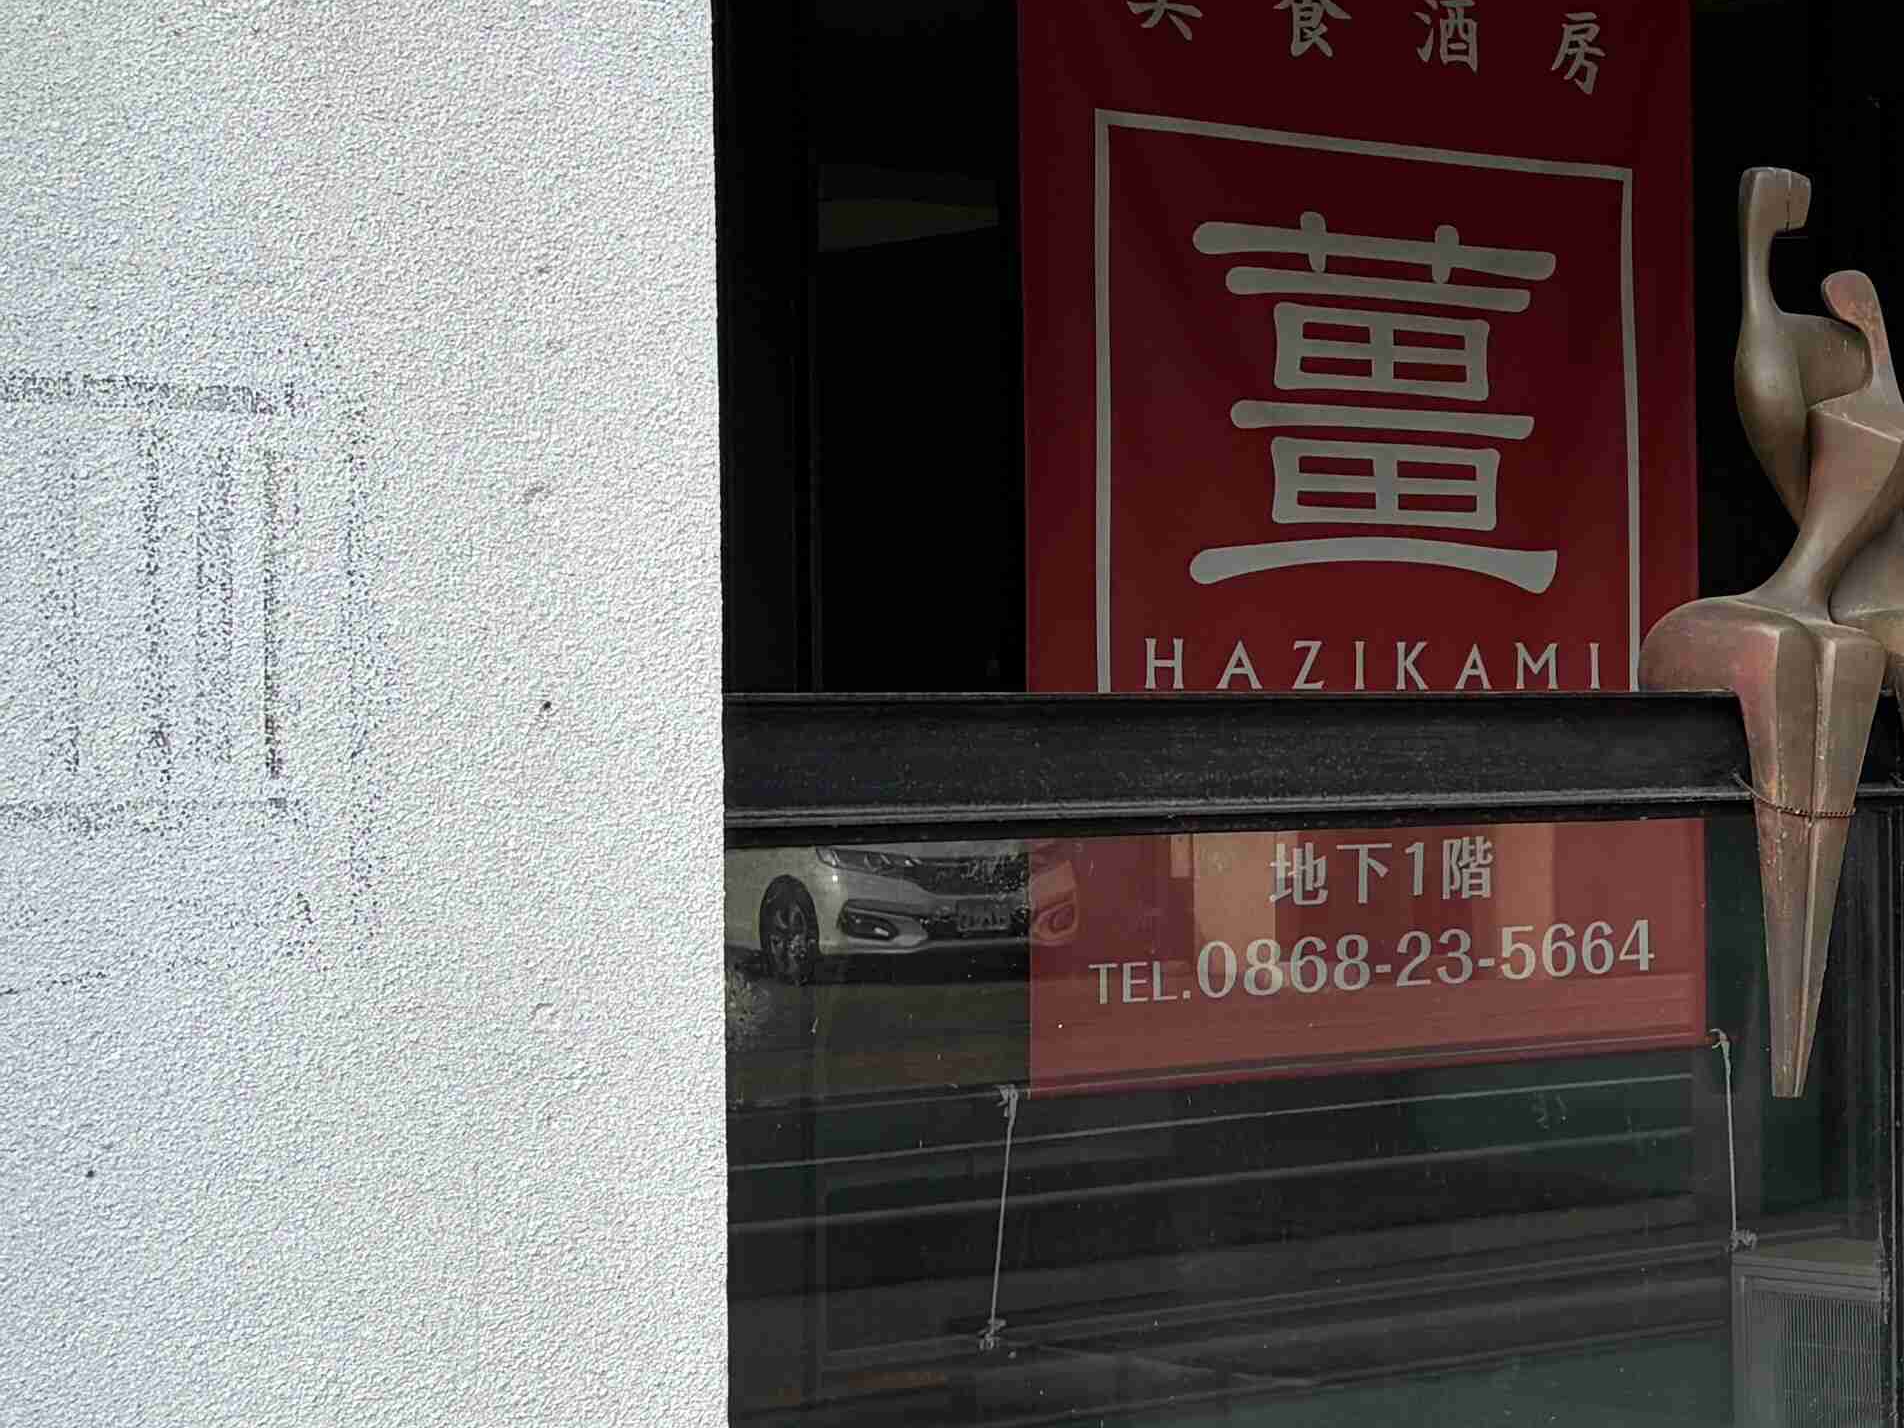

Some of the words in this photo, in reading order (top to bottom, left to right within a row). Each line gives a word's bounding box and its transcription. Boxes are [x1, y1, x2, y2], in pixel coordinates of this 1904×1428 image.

[1189, 210, 1559, 595] 薑
[1144, 637, 1602, 691] HAZIKAMI
[1268, 836, 1494, 906] 地下1階
[1088, 919, 1656, 1006] TEL.0868-23-5664
